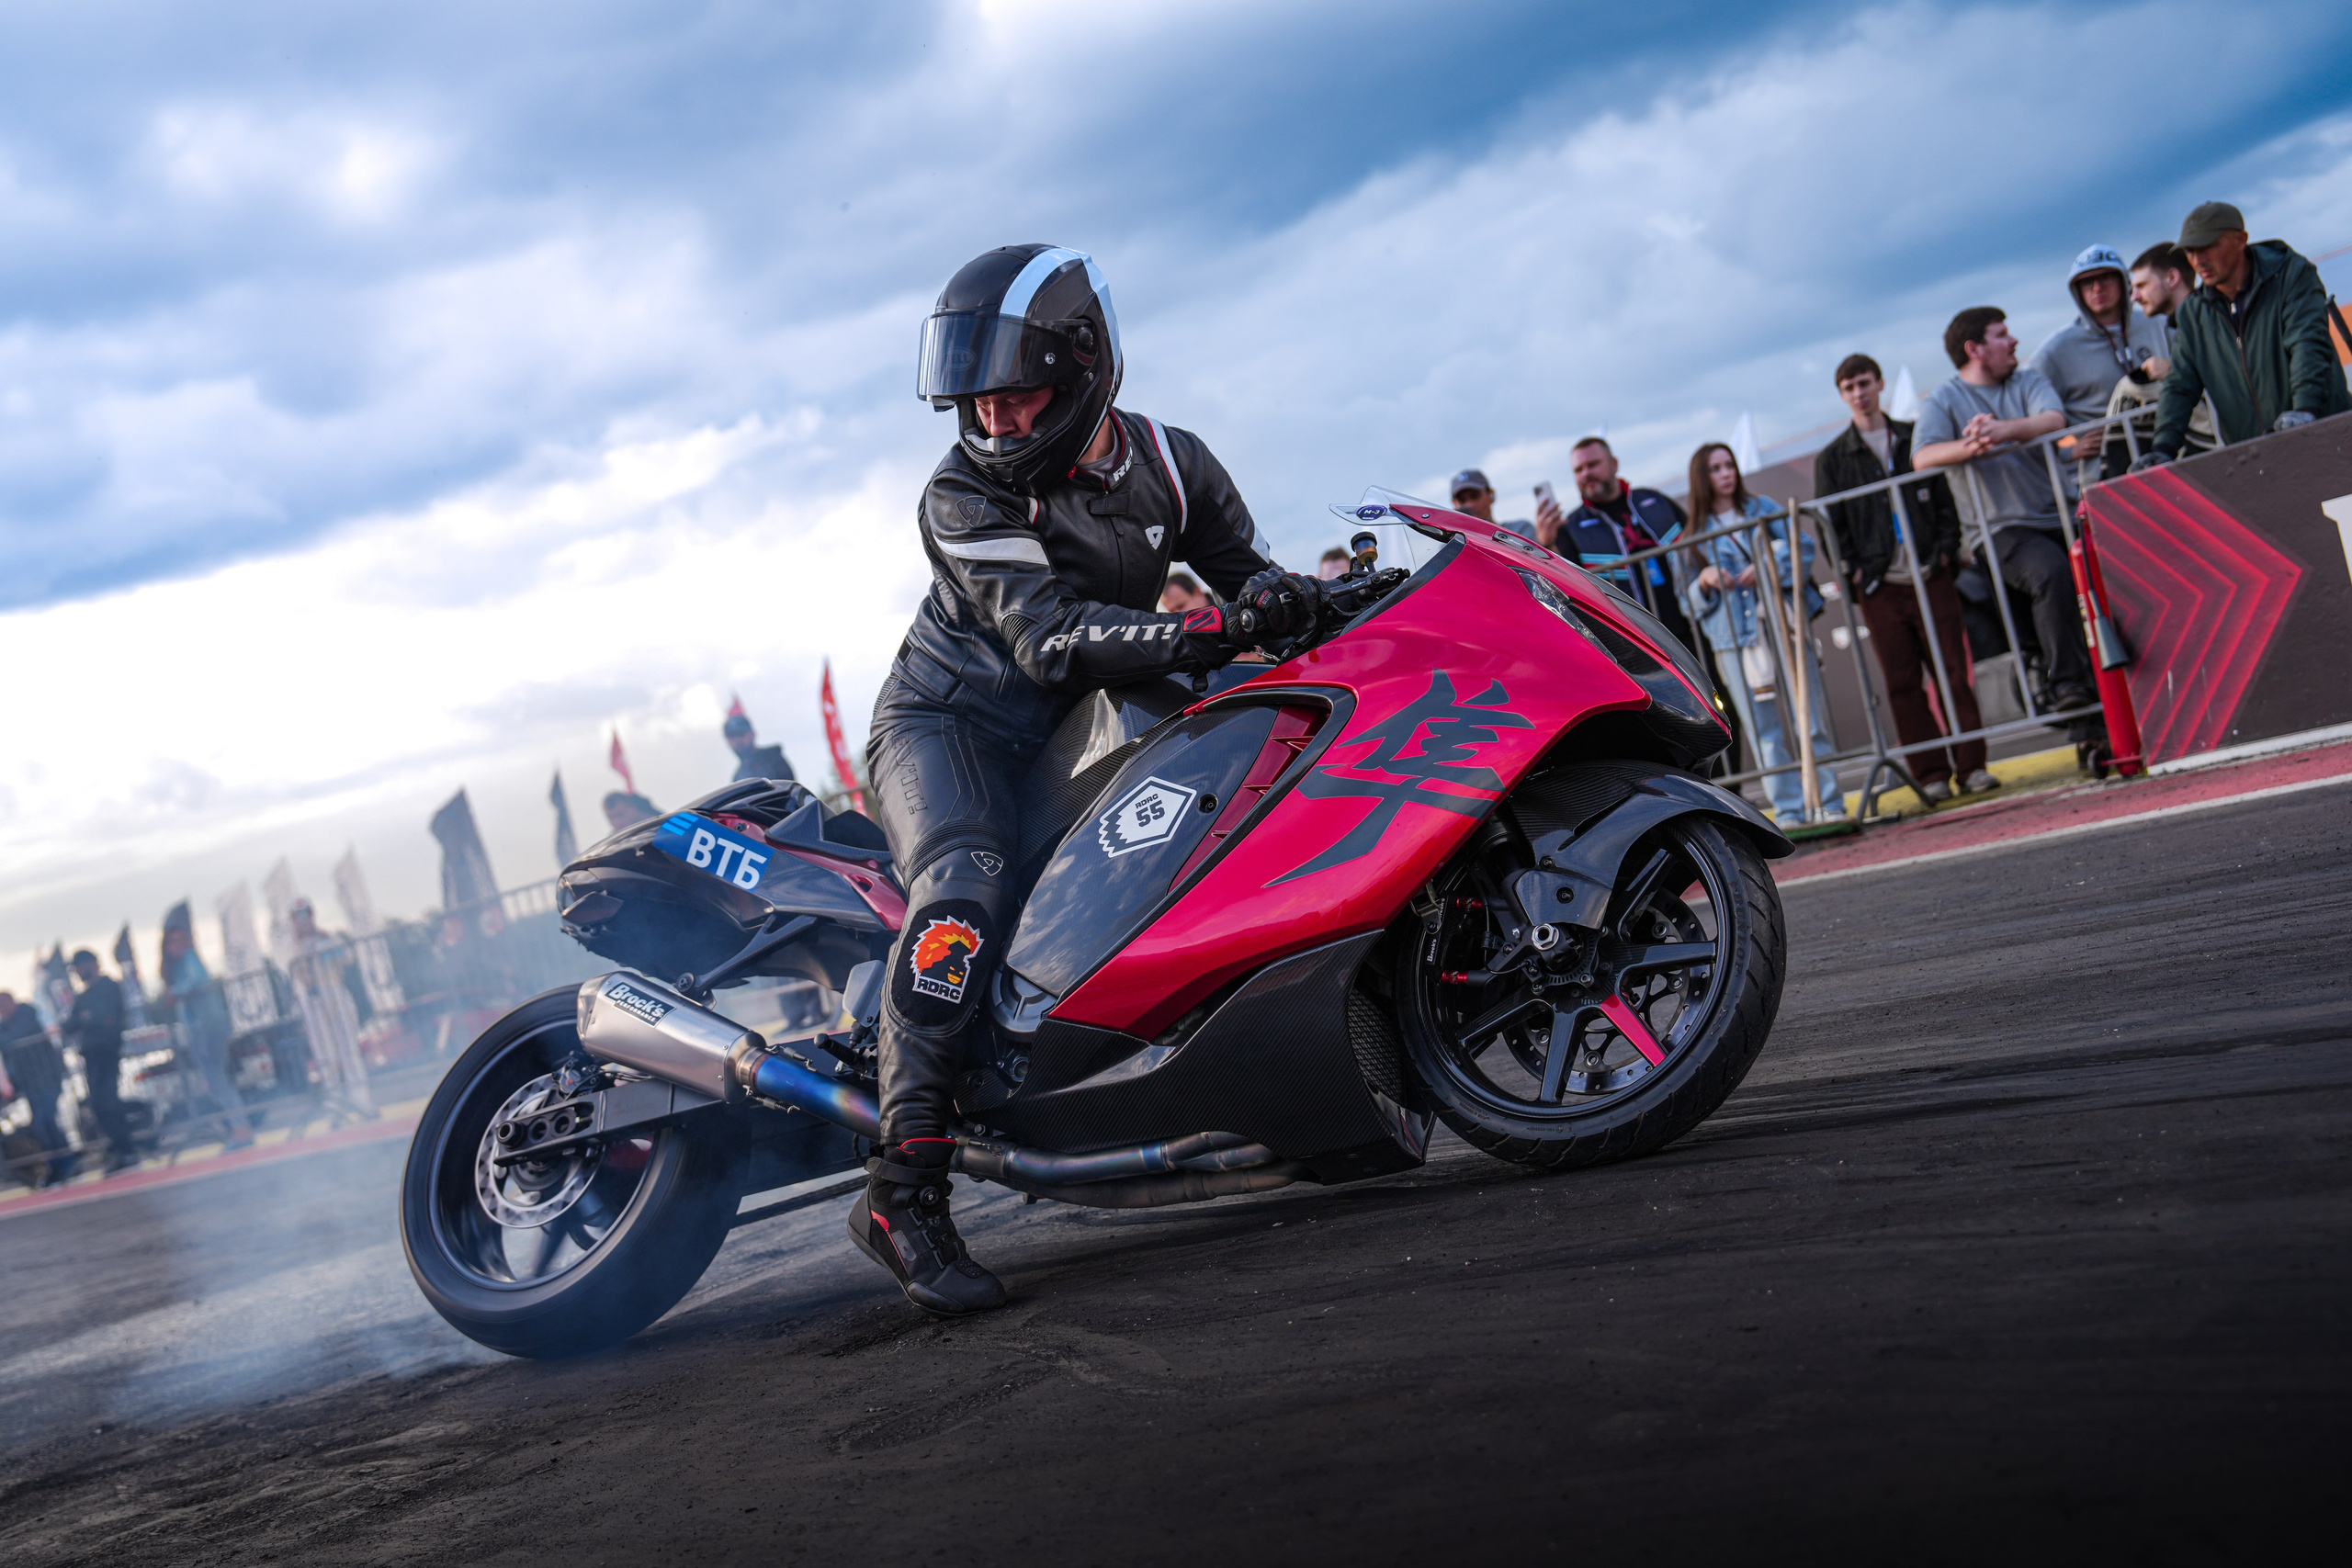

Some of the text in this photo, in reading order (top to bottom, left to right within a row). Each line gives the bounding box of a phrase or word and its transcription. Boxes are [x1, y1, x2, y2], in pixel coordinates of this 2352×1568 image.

[1040, 623, 1178, 652] REV'IT!
[1261, 668, 1536, 889] 隼
[1135, 793, 1159, 809] RDRC
[1136, 800, 1165, 827] 55
[685, 827, 768, 890] ВТБ
[608, 983, 665, 1018] Brock's
[917, 978, 962, 1000] RDRC
[616, 999, 657, 1022] PERFORMANCE
